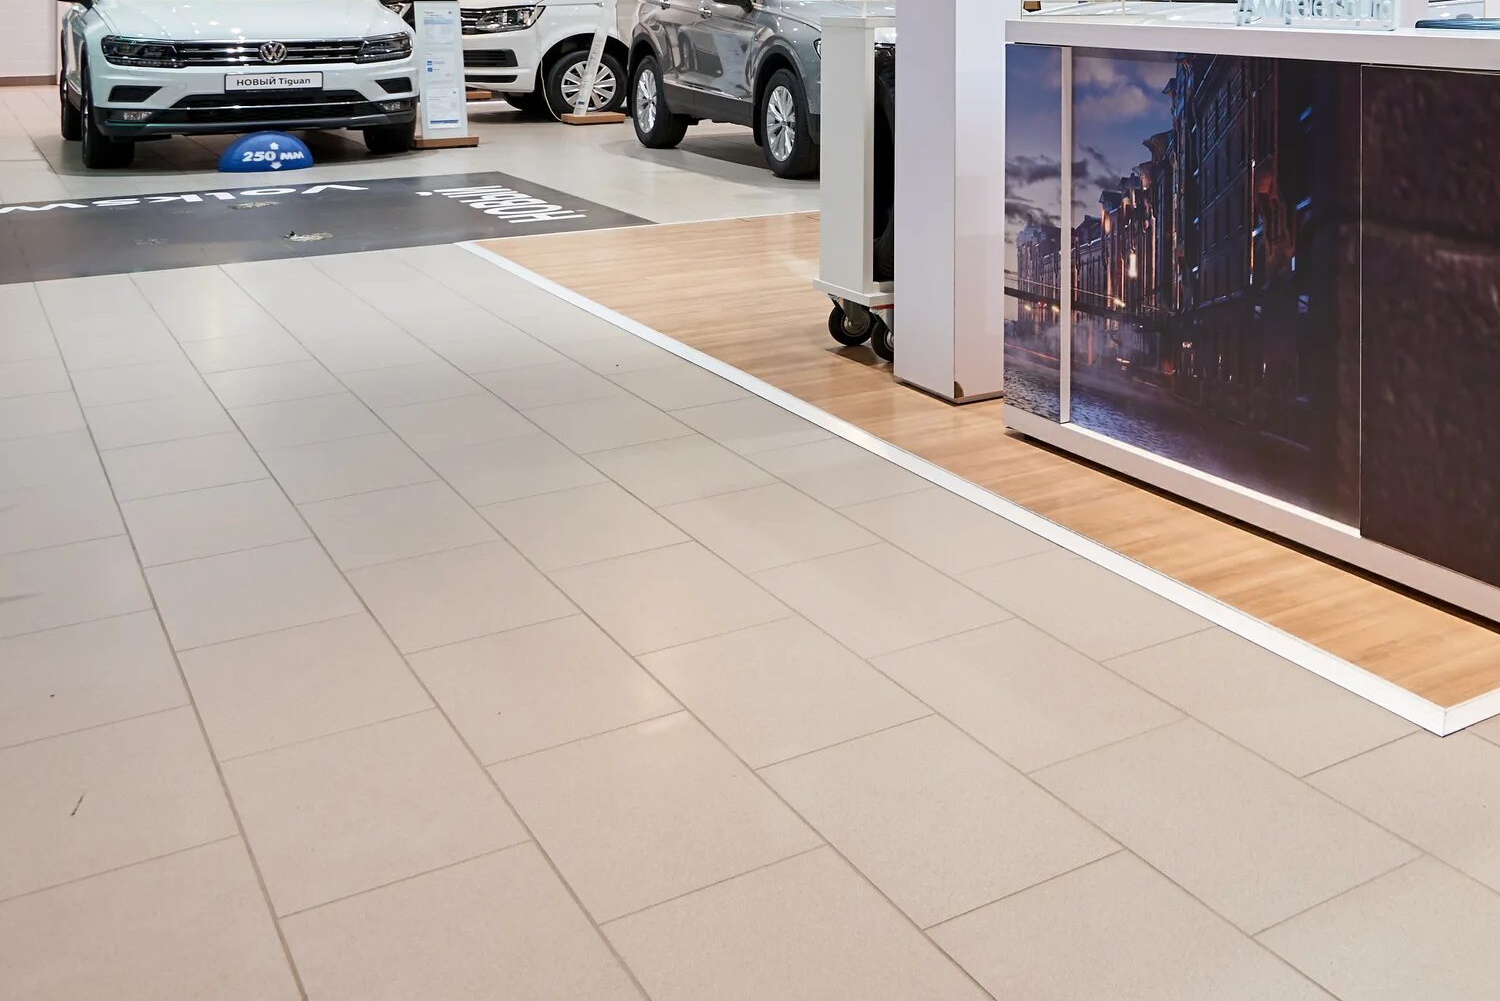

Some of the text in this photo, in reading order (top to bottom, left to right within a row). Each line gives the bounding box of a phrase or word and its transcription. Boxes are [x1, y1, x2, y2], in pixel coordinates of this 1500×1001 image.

[236, 77, 311, 88] НОВЫЙ Tiguan
[242, 150, 276, 162] 250
